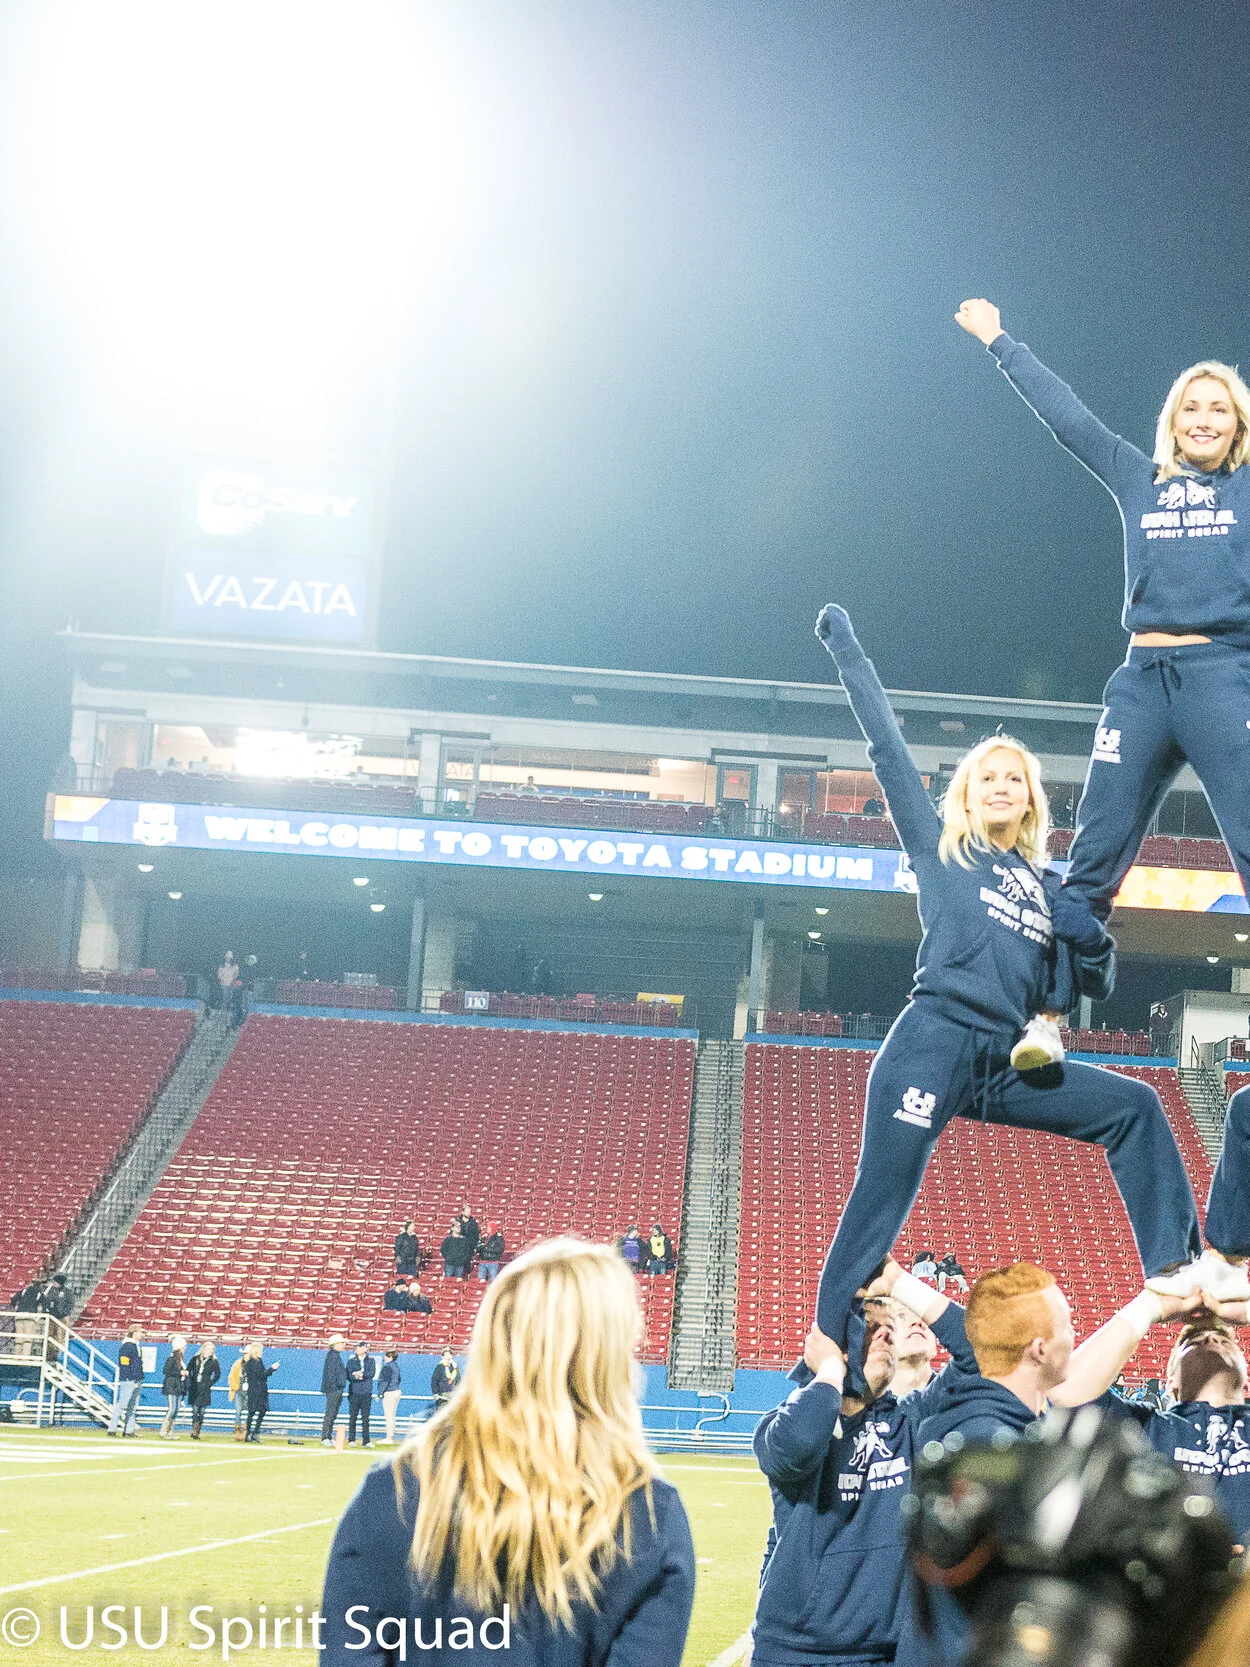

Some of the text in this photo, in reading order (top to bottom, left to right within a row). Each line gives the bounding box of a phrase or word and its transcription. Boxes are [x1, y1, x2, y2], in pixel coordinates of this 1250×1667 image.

[1146, 529, 1184, 540] SPIRIT
[184, 572, 357, 617] VAZATA
[204, 816, 873, 881] WELCOME TO TOYOTA STADIUM
[987, 907, 1021, 931] SPIRIT
[468, 997, 486, 1009] 110
[841, 1475, 904, 1502] SPI QUAD
